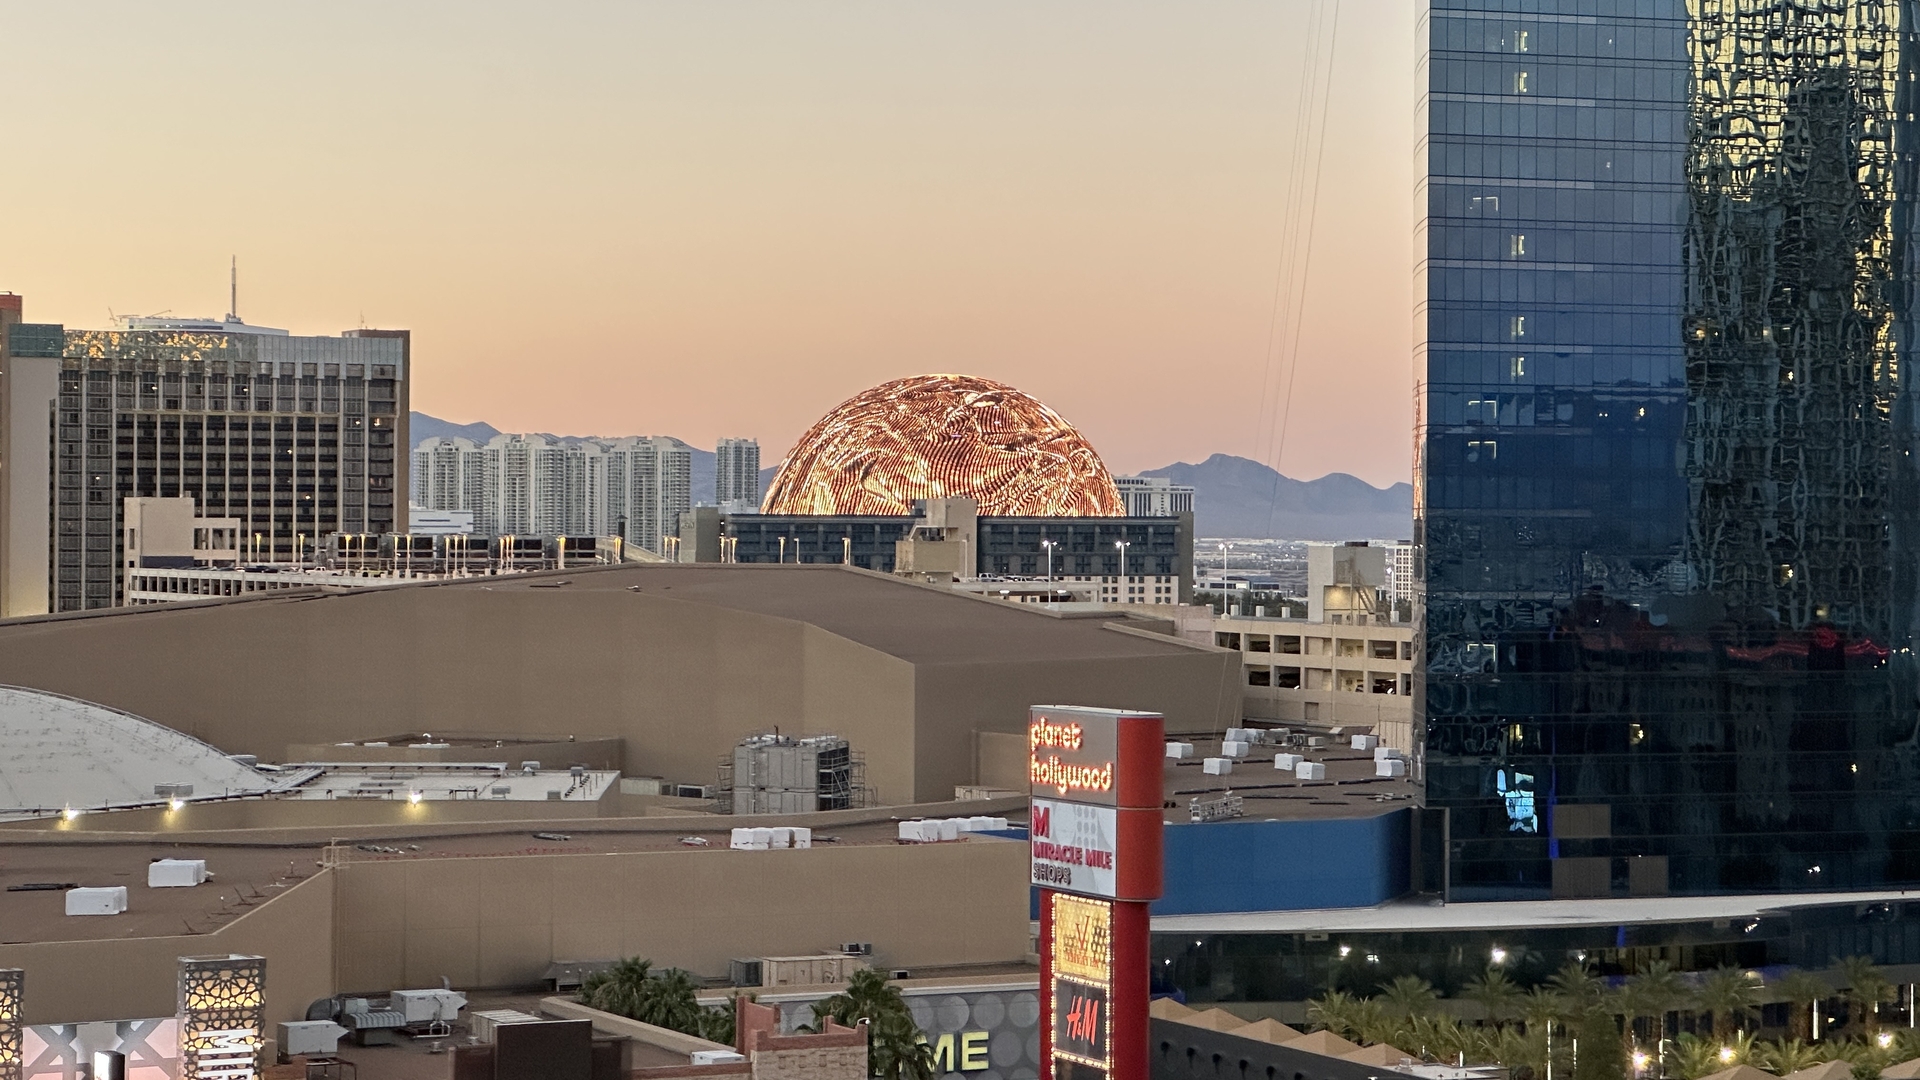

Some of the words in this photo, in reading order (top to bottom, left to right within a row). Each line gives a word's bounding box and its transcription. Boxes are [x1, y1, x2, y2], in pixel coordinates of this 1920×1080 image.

[1031, 716, 1083, 751] planet
[1031, 753, 1113, 795] hollywood
[1033, 805, 1050, 838] M
[1033, 841, 1083, 866] MIRACLE
[1085, 849, 1112, 870] MILE
[1033, 863, 1072, 885] SHOPS
[1066, 995, 1099, 1046] H&M
[897, 1031, 989, 1073] ME
